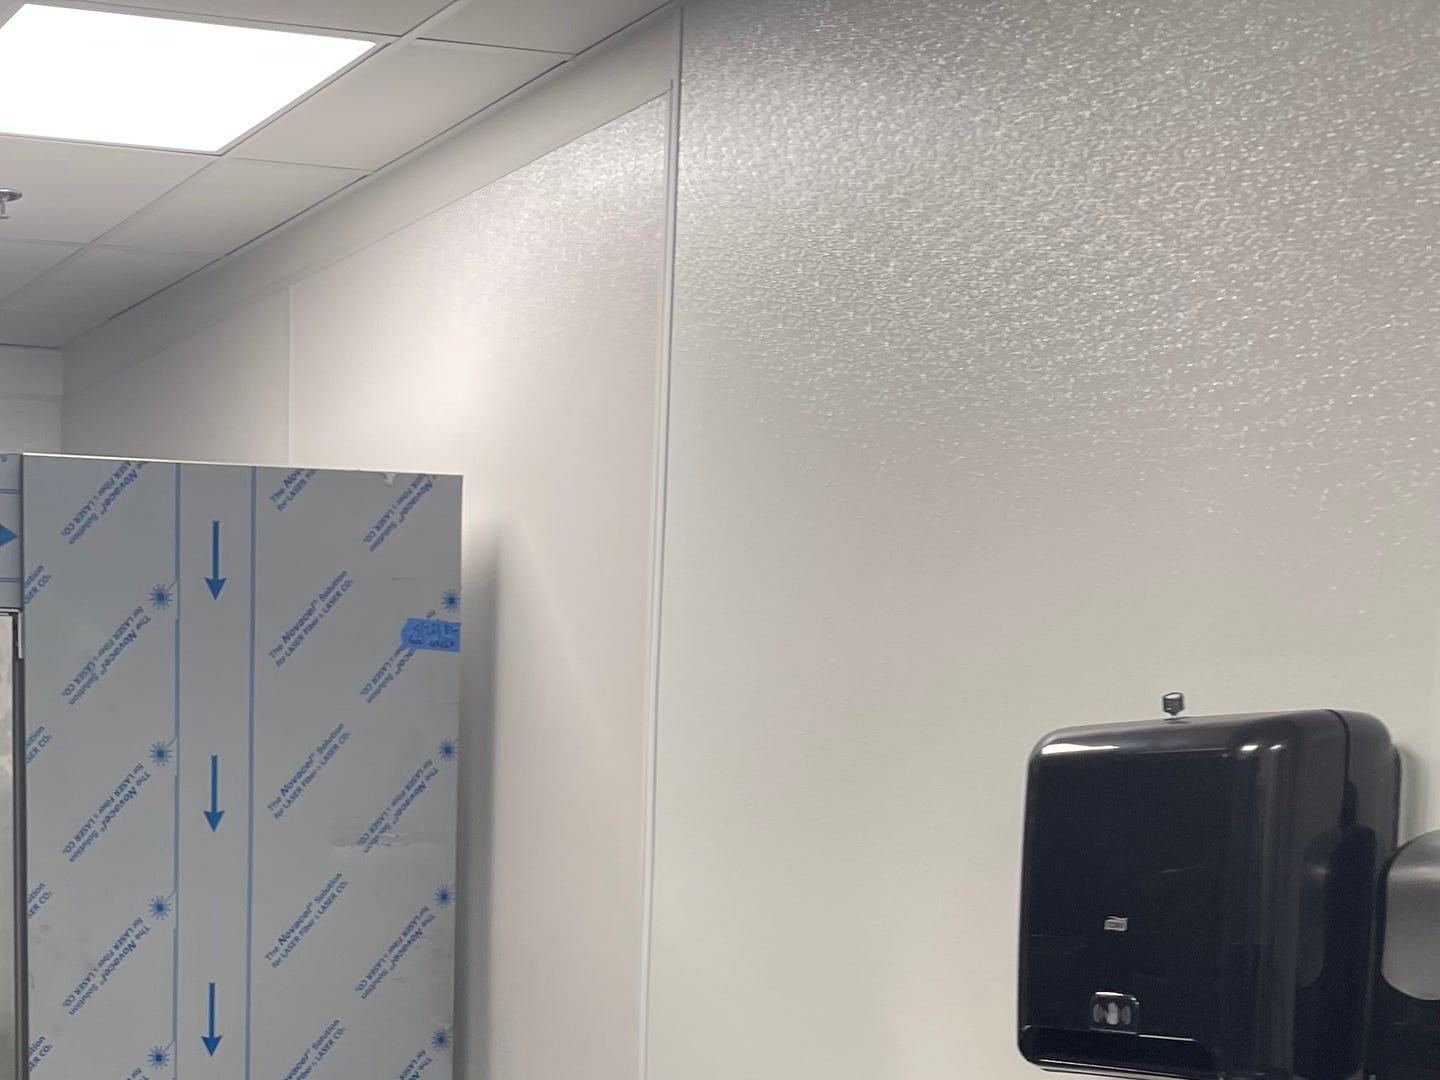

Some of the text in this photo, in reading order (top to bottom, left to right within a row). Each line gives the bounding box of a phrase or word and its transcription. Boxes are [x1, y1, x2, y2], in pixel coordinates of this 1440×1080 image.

[287, 479, 307, 502] LASER
[74, 501, 96, 524] LASER
[69, 514, 99, 545] Solution
[113, 617, 135, 641] LASER
[136, 616, 152, 631] The
[285, 635, 305, 657] LASER
[323, 591, 343, 614] LASER
[74, 662, 96, 685] LASER
[69, 673, 100, 706] Solution
[114, 774, 135, 798] LASER
[137, 772, 151, 787] The
[283, 787, 304, 809] LASER
[320, 744, 340, 766] LASER
[75, 819, 96, 842] LASER
[70, 831, 100, 863] Solution
[135, 926, 151, 941] The
[281, 937, 302, 959] LASER
[318, 893, 338, 915] LASER
[114, 928, 134, 951] LASER
[74, 973, 96, 996] LASER
[70, 984, 99, 1016] Solution
[315, 1040, 335, 1062] LASER
